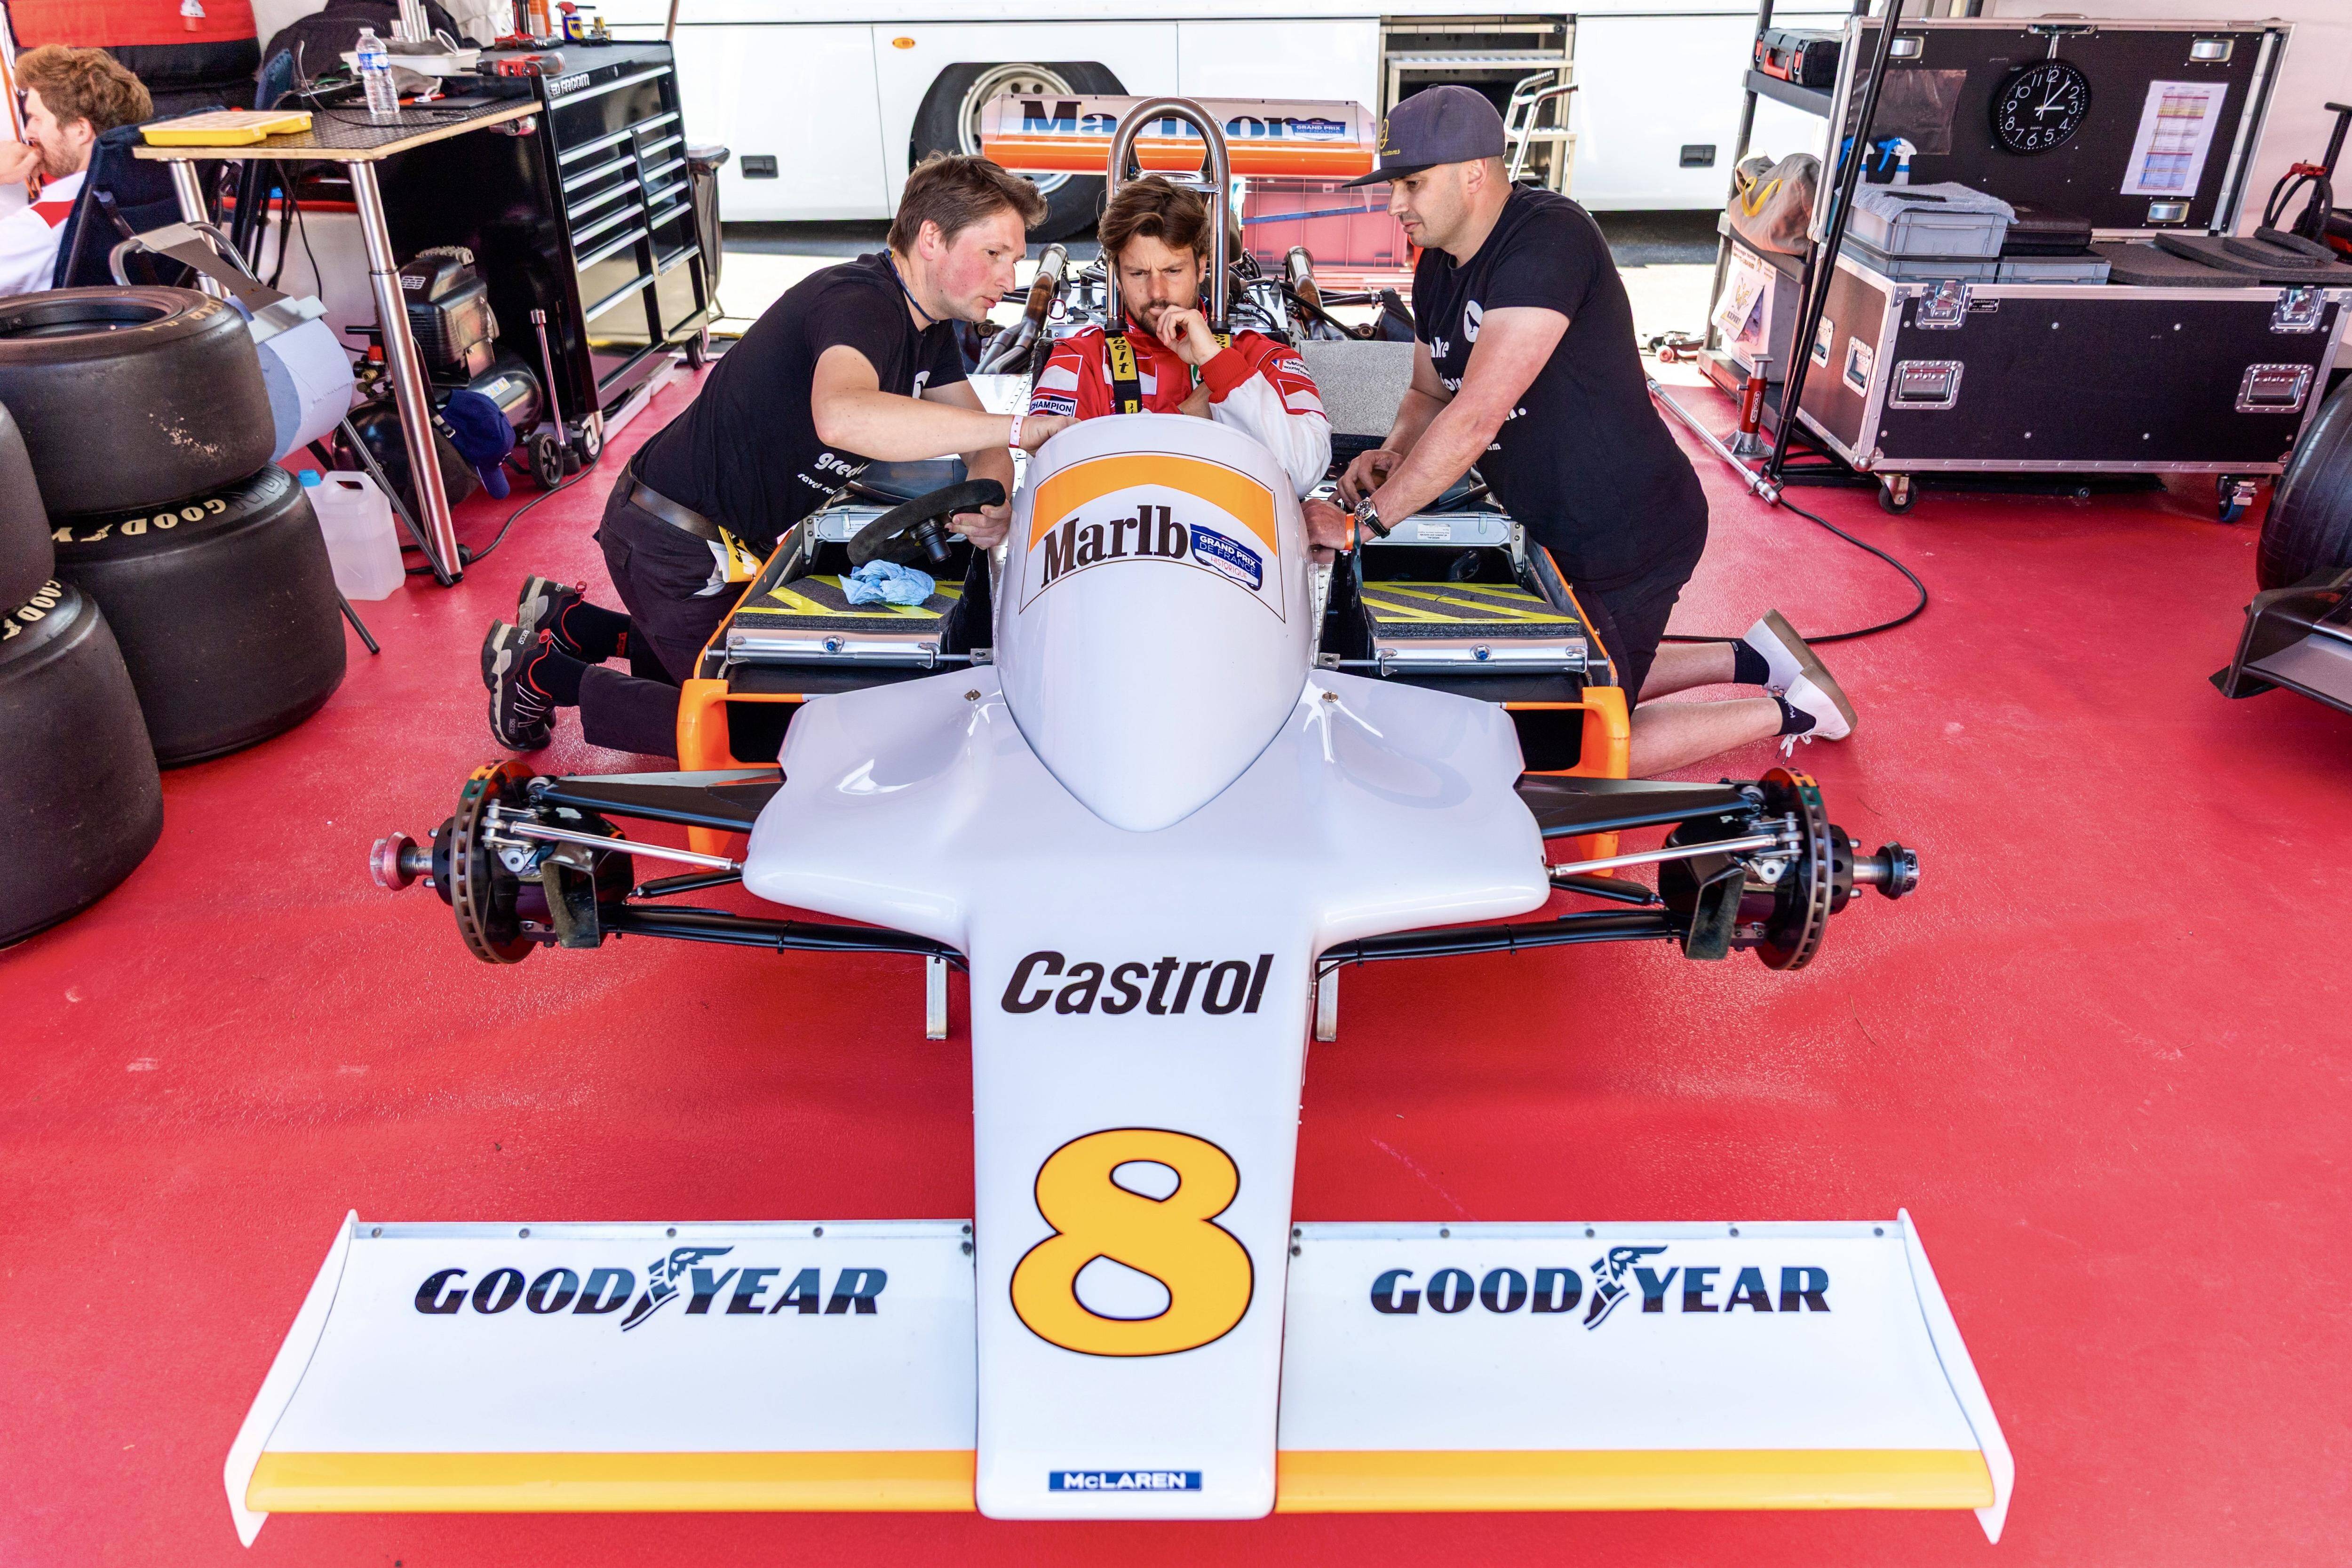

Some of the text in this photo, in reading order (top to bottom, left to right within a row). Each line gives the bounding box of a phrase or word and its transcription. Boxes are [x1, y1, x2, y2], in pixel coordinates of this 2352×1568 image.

[2031, 73, 2043, 87] 11
[2015, 85, 2031, 99] 10
[2067, 86, 2080, 99] 2
[2006, 100, 2018, 114] 9
[2068, 101, 2078, 115] 3
[2004, 116, 2015, 131] 8
[2058, 117, 2069, 129] 4
[2014, 128, 2025, 142] 7
[2026, 132, 2037, 146] 6
[2043, 128, 2055, 142] 5
[1112, 337, 1130, 374] belt
[1030, 401, 1072, 413] CHAMPION
[1199, 541, 1255, 576] DE FRANCE
[1200, 535, 1256, 569] GRAND PRIX
[1210, 556, 1248, 579] HISTORIQUE
[1000, 949, 1275, 1015] Castrol
[1009, 1126, 1255, 1357] 8
[1063, 1472, 1187, 1489] McLAREN
